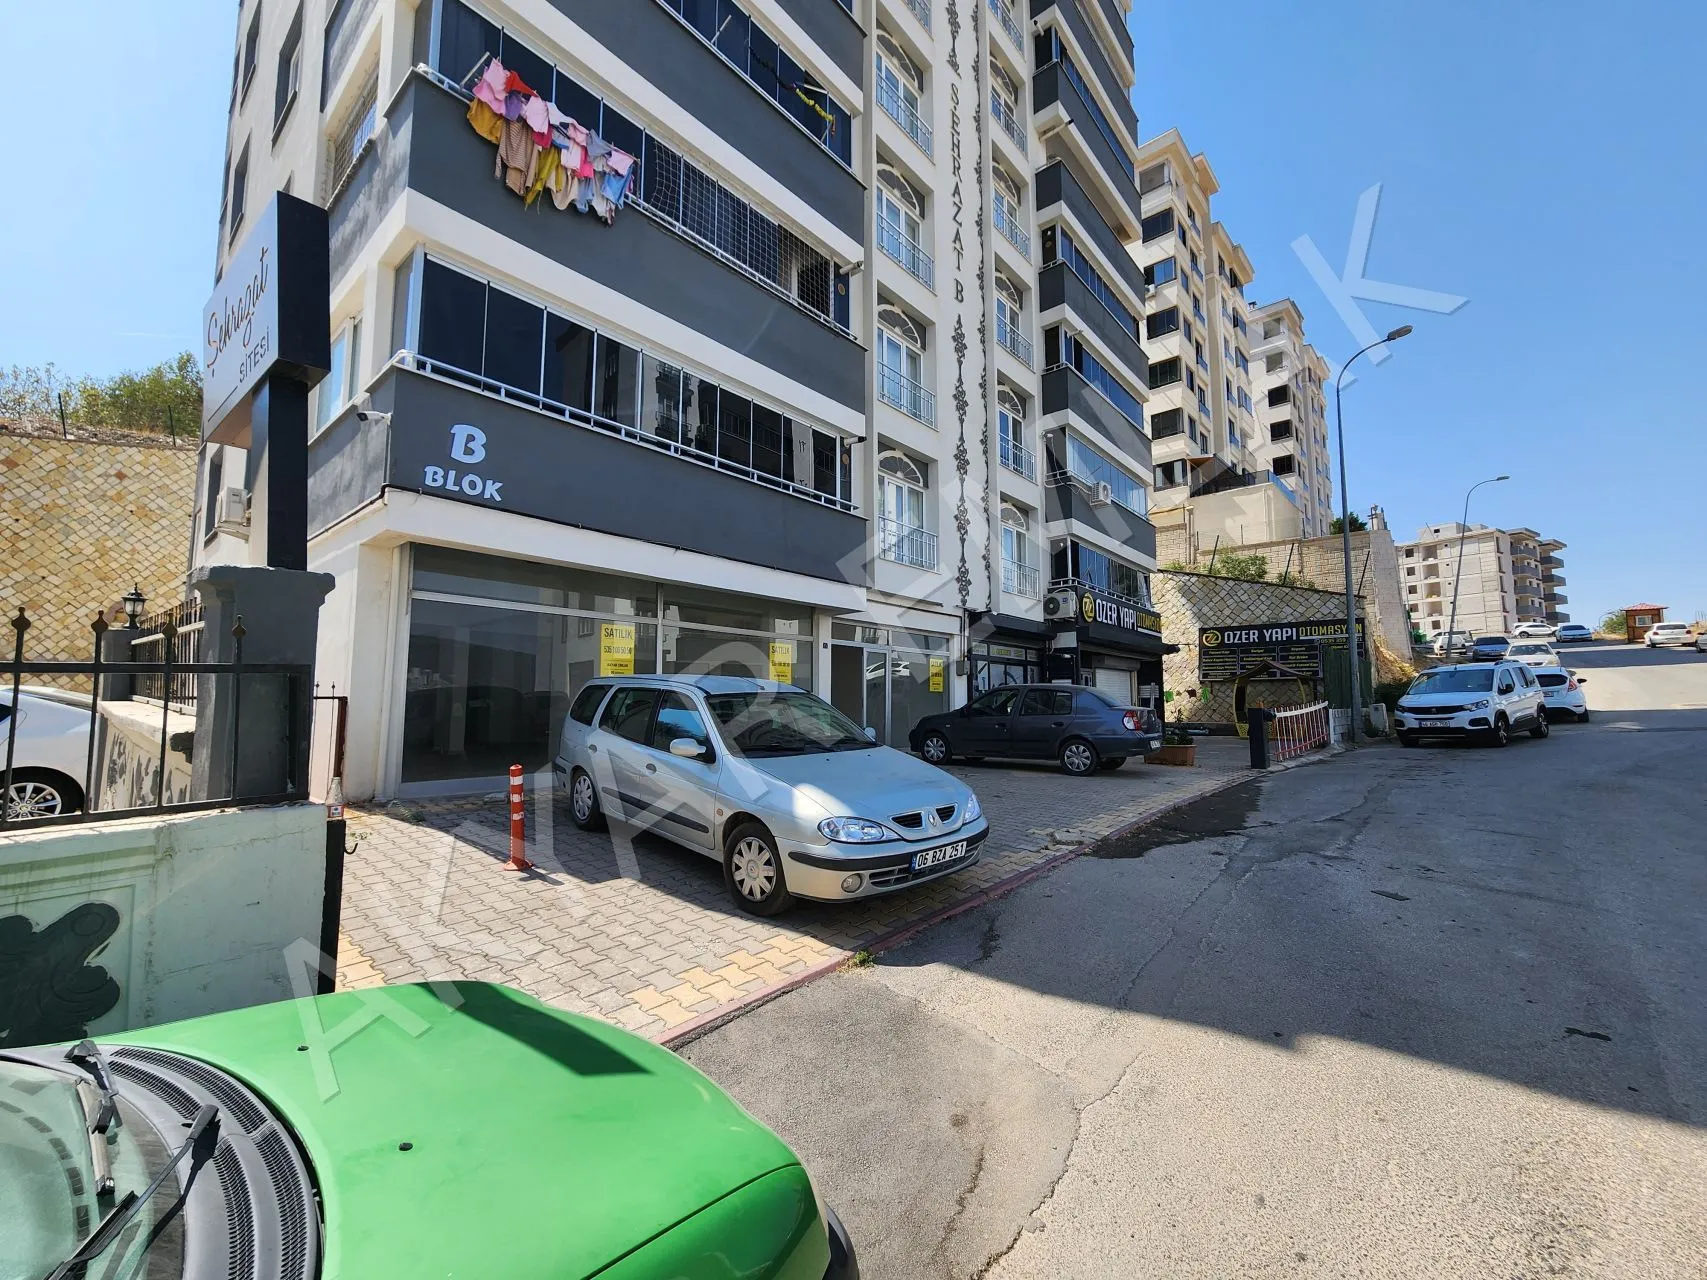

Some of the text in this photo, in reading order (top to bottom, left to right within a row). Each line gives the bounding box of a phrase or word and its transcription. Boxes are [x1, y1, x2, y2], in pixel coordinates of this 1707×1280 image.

[953, 278, 964, 303] B
[239, 326, 270, 384] SİTESİ
[450, 424, 487, 464] B
[424, 465, 503, 502] BLOK
[1119, 606, 1137, 631] YAPI
[604, 627, 633, 640] SATILIK
[1263, 627, 1297, 642] YAPI
[1299, 623, 1362, 637] OTOMASYN
[917, 843, 965, 867] 06 BZA 251
